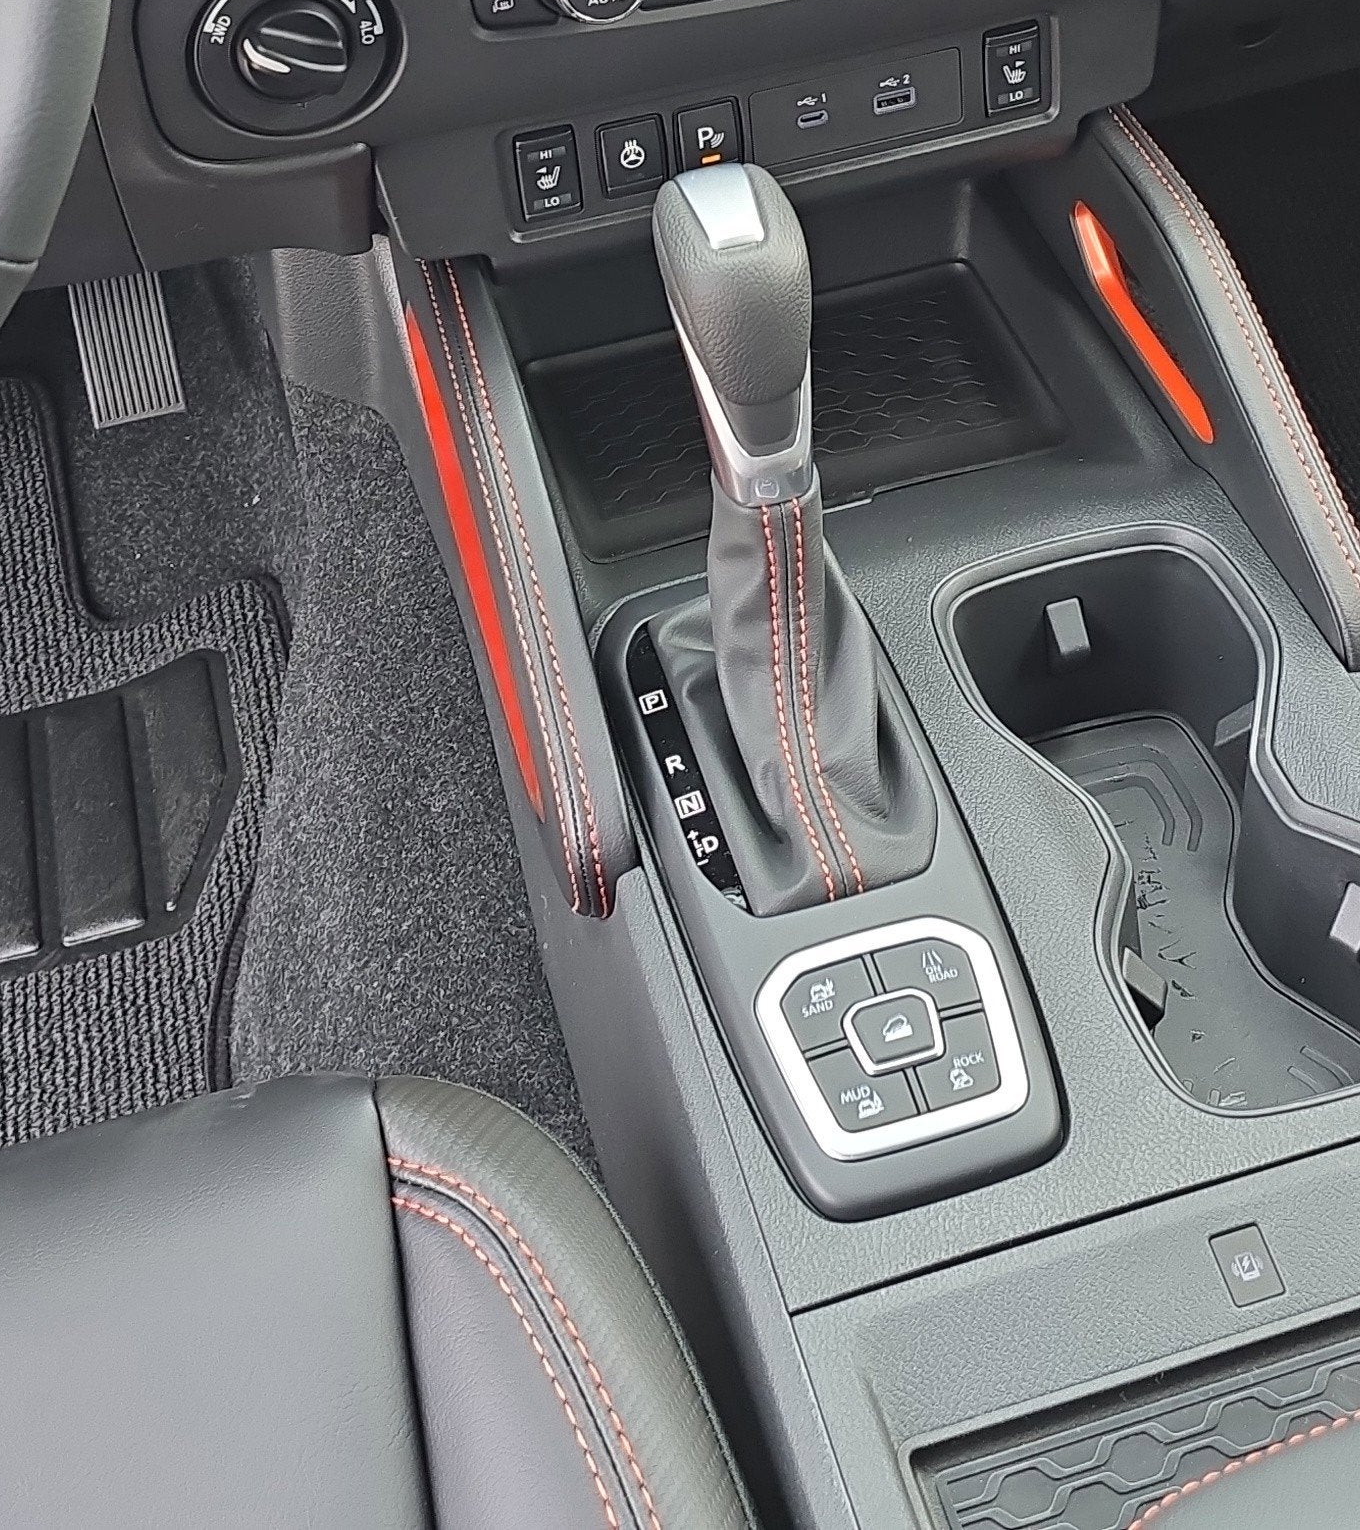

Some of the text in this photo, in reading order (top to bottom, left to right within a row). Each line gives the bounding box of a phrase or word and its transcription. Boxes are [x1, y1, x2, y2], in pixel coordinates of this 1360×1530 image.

[210, 14, 232, 45] 2WD
[358, 19, 375, 46] 4LO
[1008, 44, 1021, 55] HI
[902, 74, 911, 85] 2
[1009, 90, 1024, 102] LO
[696, 126, 714, 150] P
[539, 149, 553, 160] HI
[544, 196, 560, 208] LO
[665, 754, 686, 775] R
[701, 835, 719, 854] D
[929, 968, 958, 984] ROAD
[801, 998, 834, 1018] SAND
[953, 1051, 986, 1069] ROCK
[840, 1085, 871, 1105] MUD
